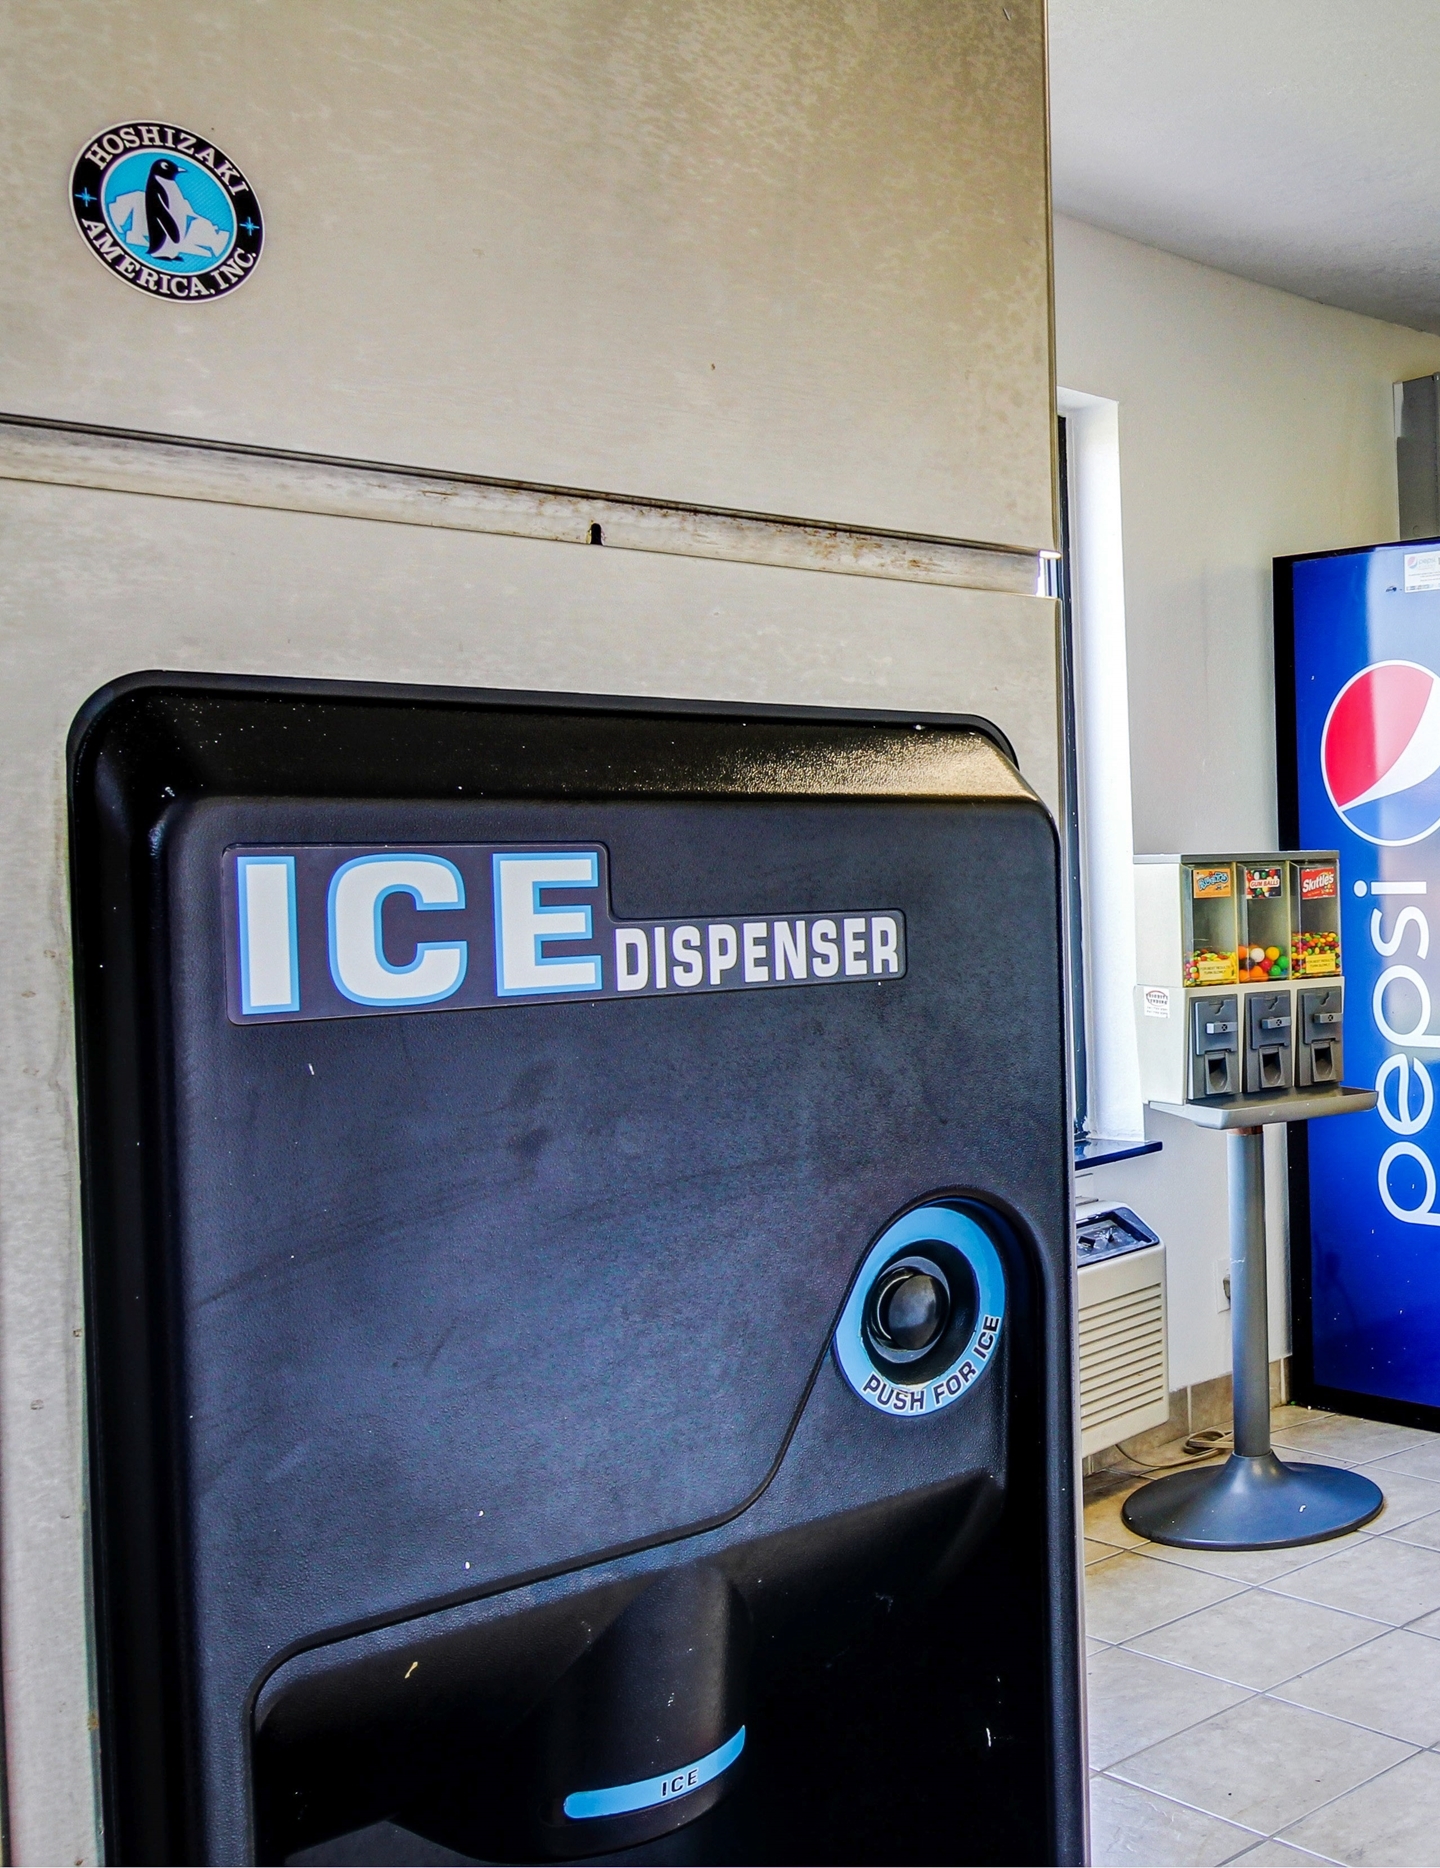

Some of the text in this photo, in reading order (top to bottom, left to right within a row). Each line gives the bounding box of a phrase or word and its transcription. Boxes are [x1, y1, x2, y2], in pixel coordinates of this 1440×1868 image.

[85, 125, 249, 196] HOSHIZAKI
[81, 218, 257, 297] AMERICA, INC.
[1302, 873, 1334, 892] Skittles
[236, 851, 899, 1016] ICE DISPENSER
[862, 1315, 1000, 1411] PUSH FOR ICE
[661, 1768, 698, 1798] ICE
